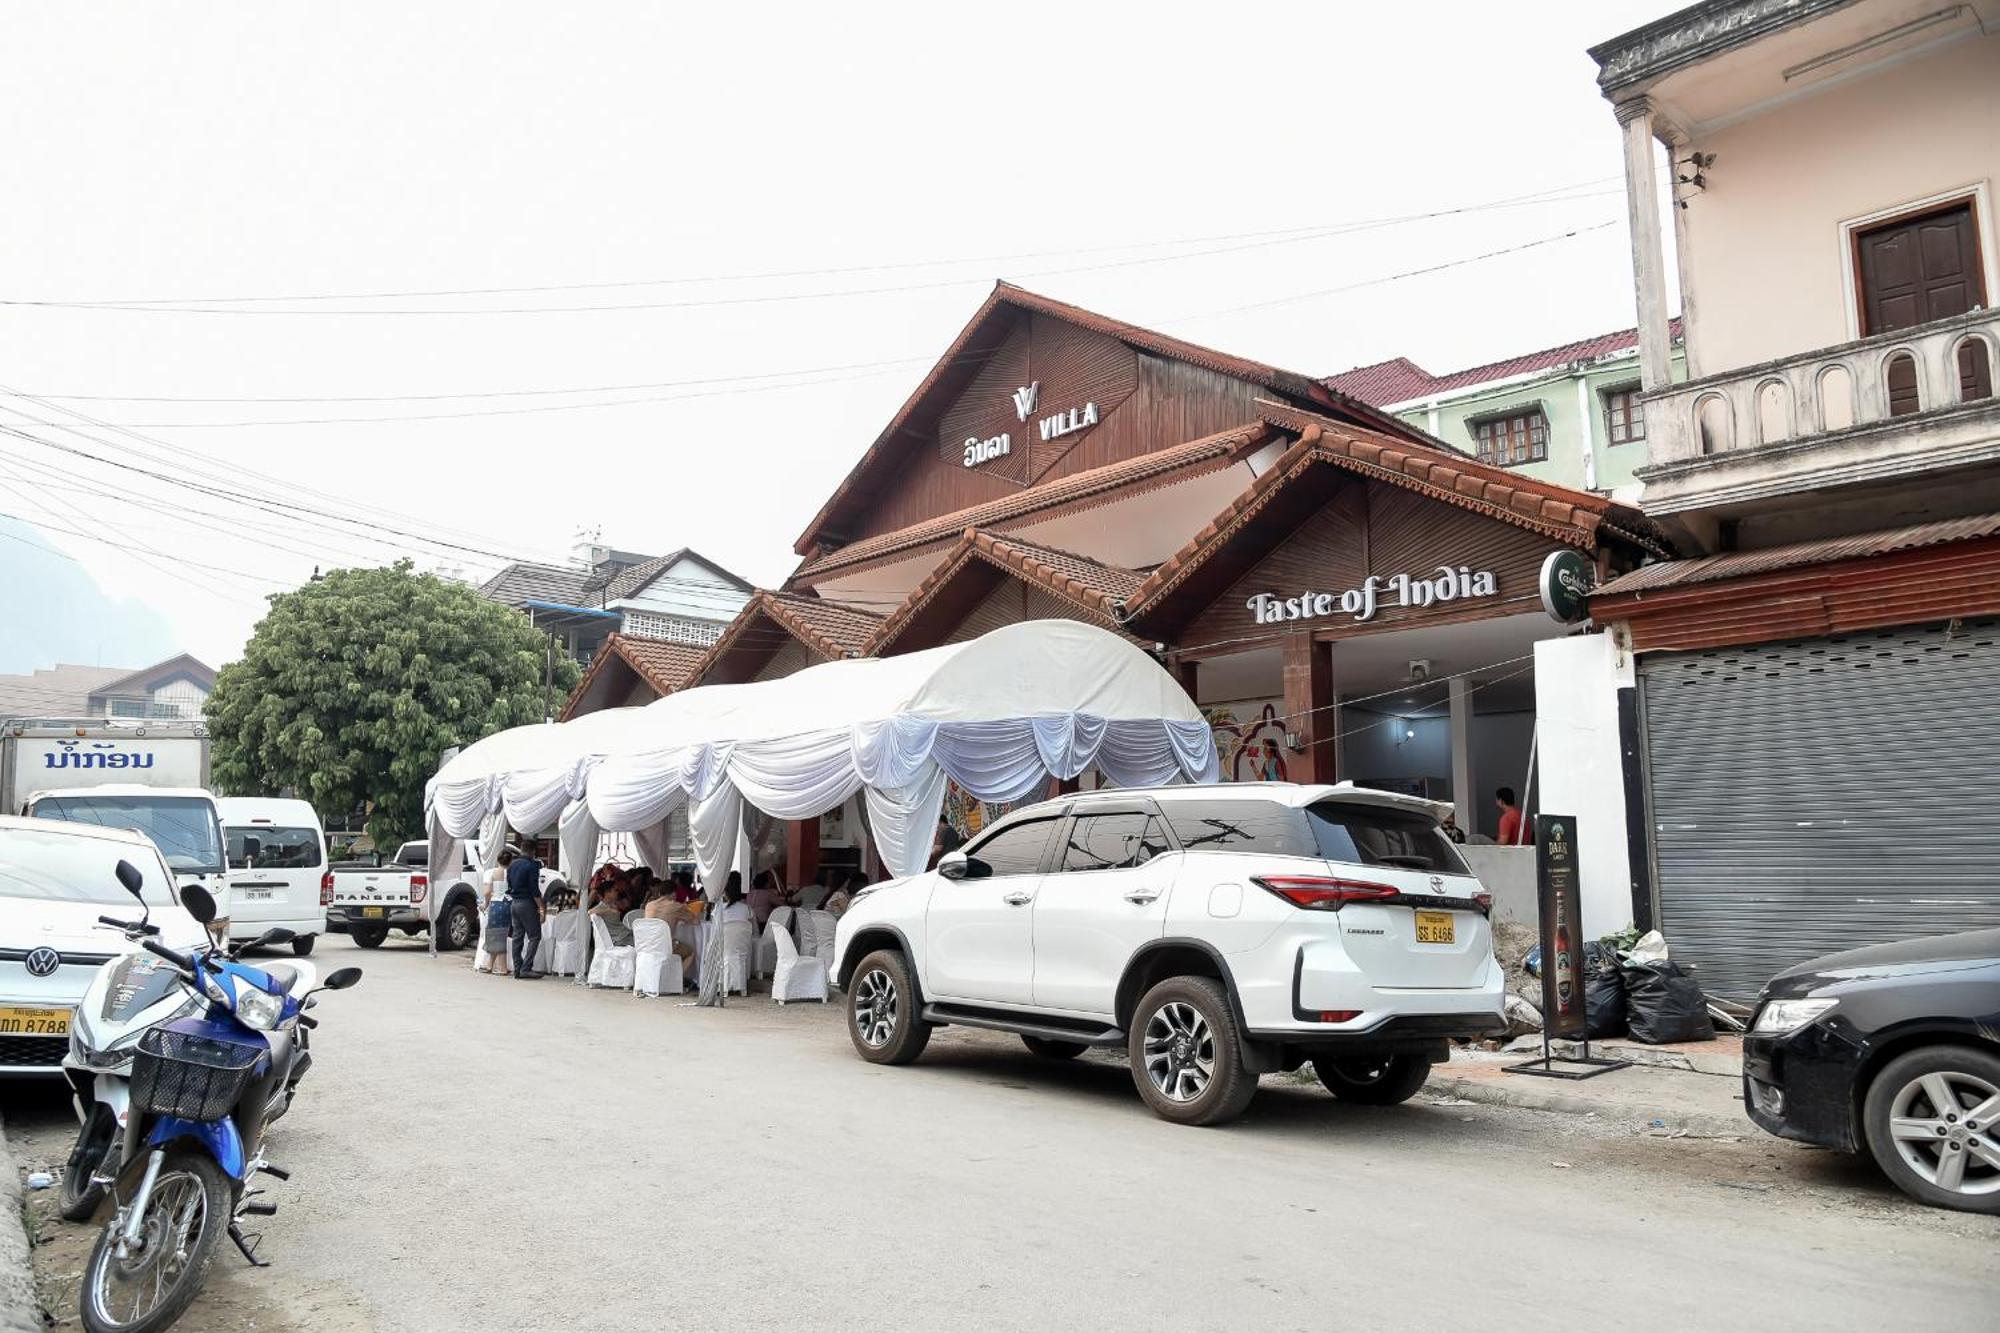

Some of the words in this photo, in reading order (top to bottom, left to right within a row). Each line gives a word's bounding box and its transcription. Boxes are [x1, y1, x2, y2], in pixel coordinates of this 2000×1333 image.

[1039, 402, 1098, 440] VILLA
[1247, 593, 1334, 625] Taste
[1341, 575, 1381, 620] of
[1389, 566, 1497, 607] India
[25, 1019, 67, 1034] 8788
